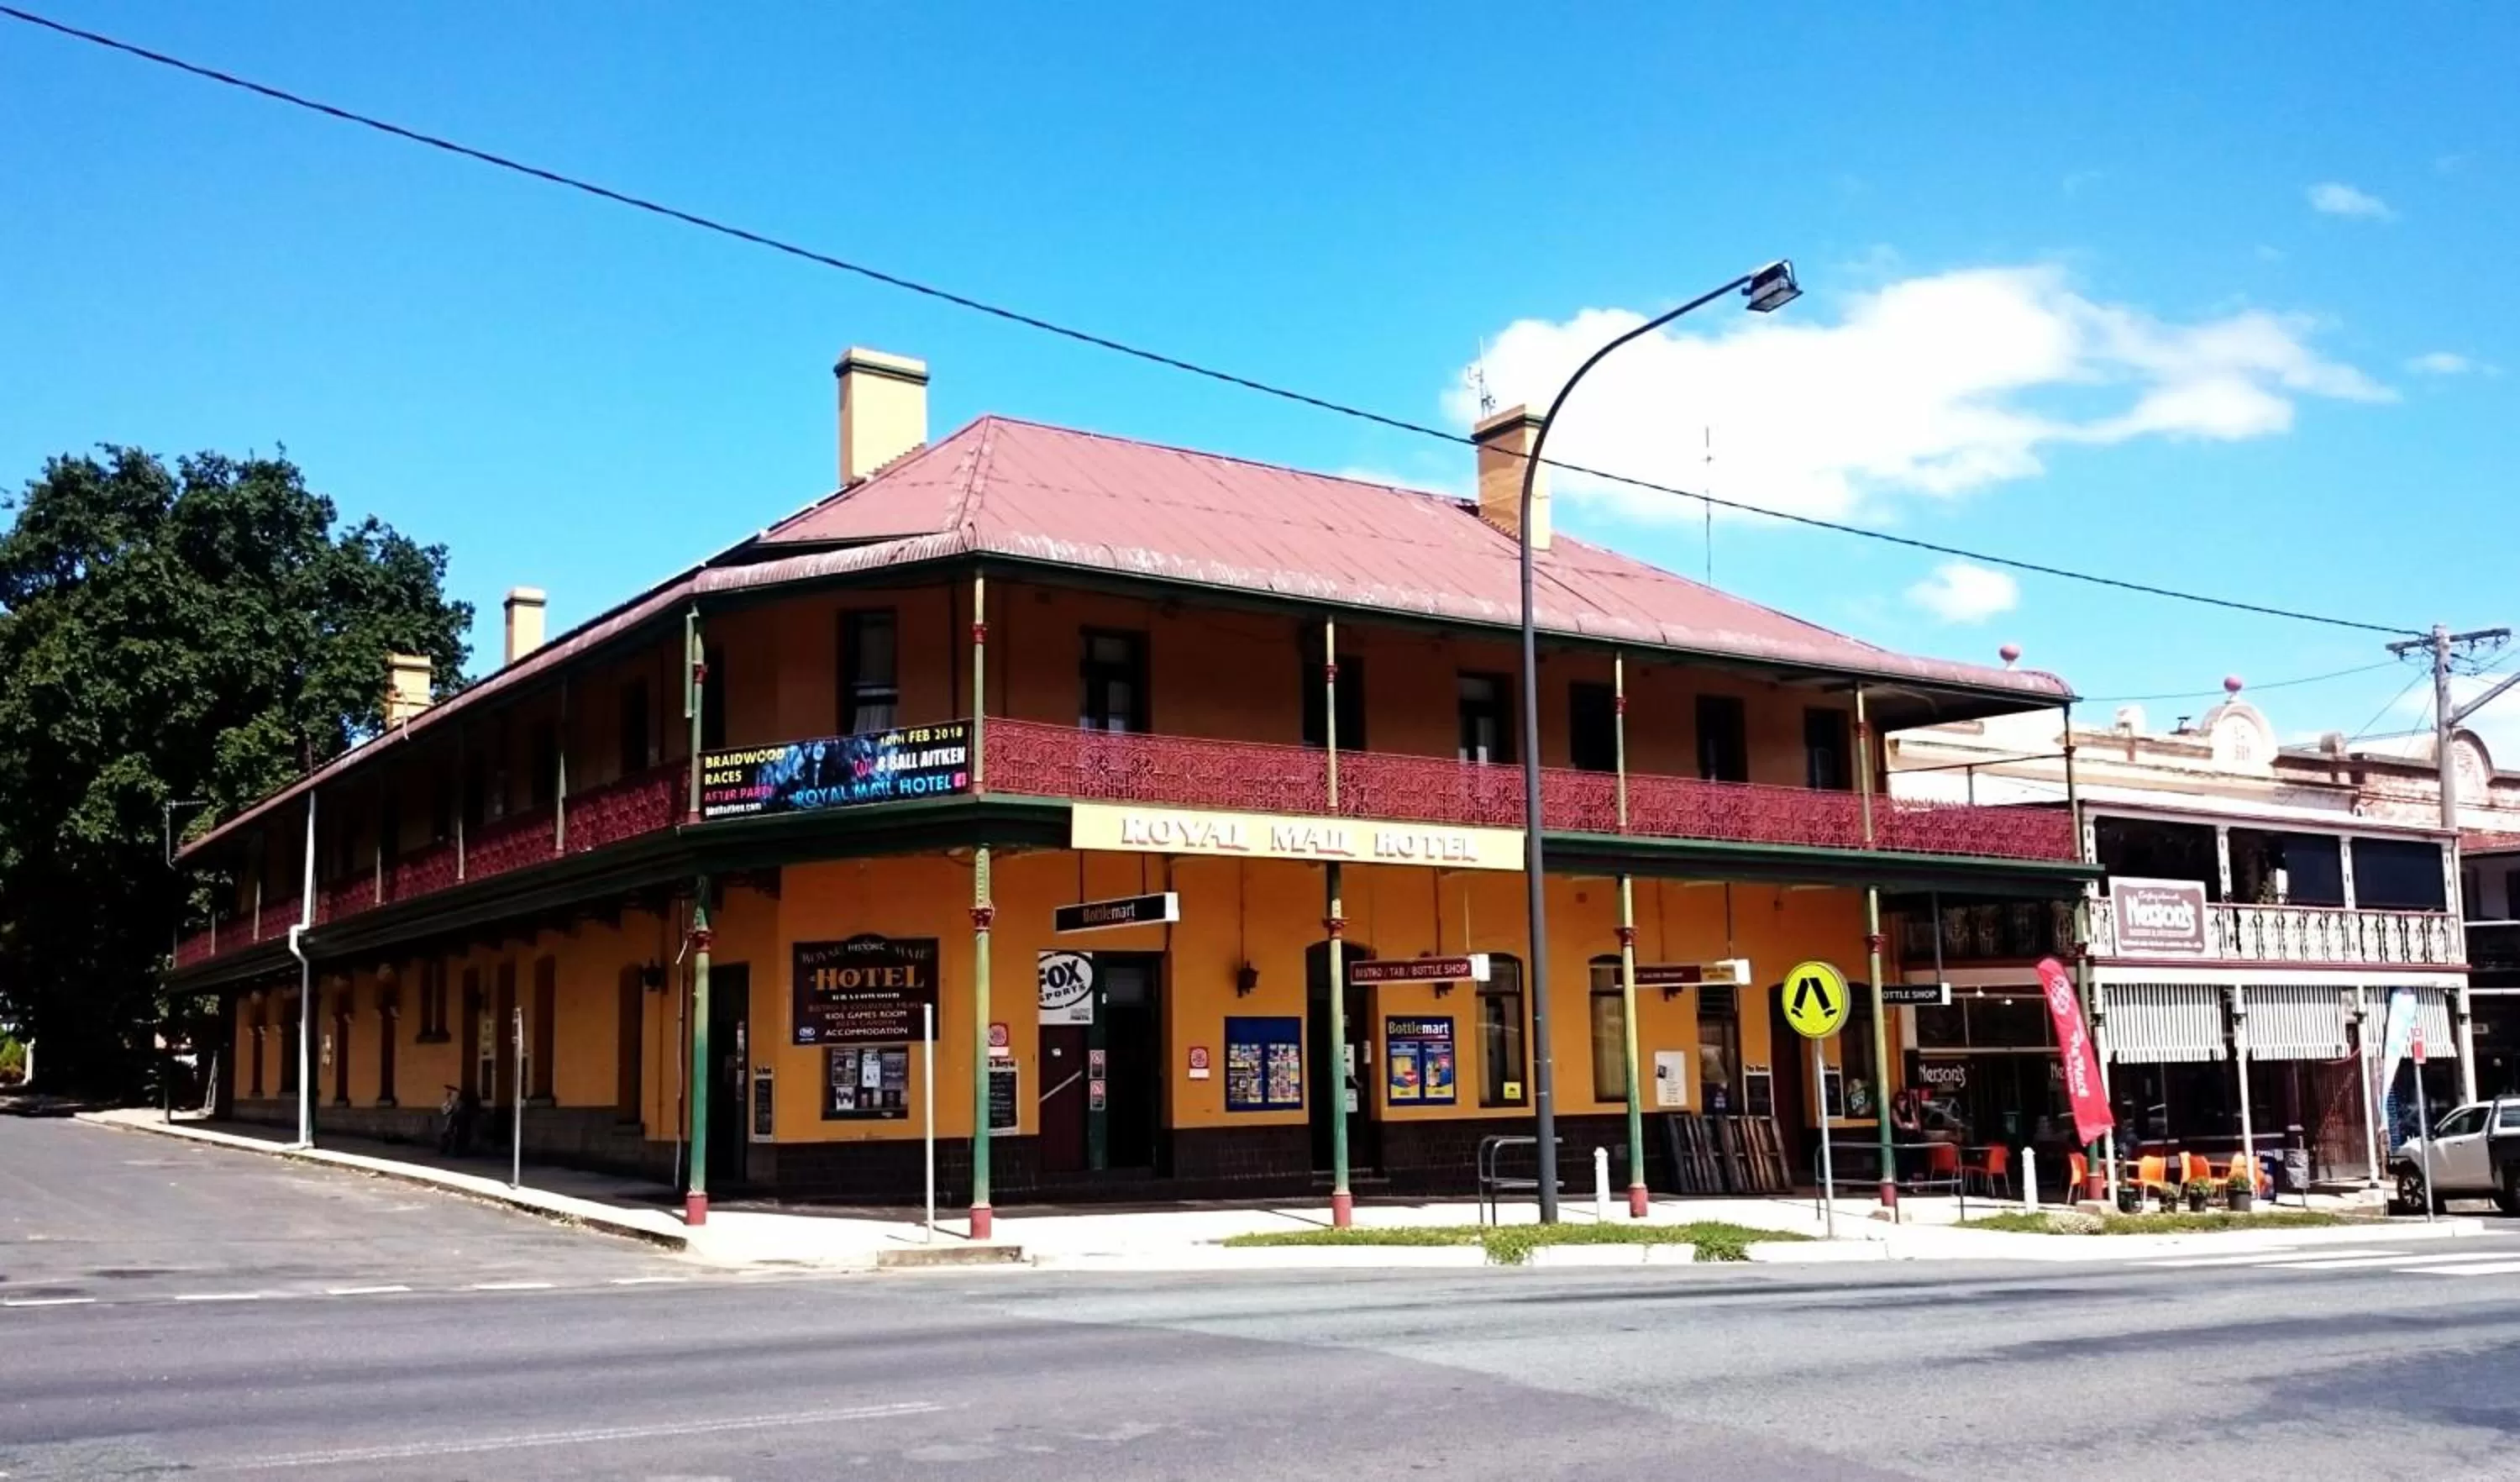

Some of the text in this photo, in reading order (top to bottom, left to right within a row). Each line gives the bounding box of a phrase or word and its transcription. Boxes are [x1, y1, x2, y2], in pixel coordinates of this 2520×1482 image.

[908, 728, 930, 744] FEB
[935, 726, 963, 740] 2018
[705, 747, 785, 769] BRAIDWOOD
[889, 751, 918, 771] BALL
[920, 746, 966, 768] AITKEN
[705, 770, 743, 786] RACES
[705, 785, 774, 802] AFTER PARTY
[795, 784, 848, 806] ROYAL
[899, 774, 952, 795] HOTEL
[1121, 817, 1478, 863] ROYAL MAIL HOTEL
[815, 964, 925, 991] HOTEL
[1038, 959, 1084, 993] FOX
[1355, 967, 1383, 979] BISTRO
[1389, 966, 1405, 977] TAB
[1411, 964, 1442, 975] BOTTLE
[1444, 963, 1467, 975] SHOP
[1038, 983, 1086, 1002] SPORTS
[1882, 990, 1937, 1000] OTTLE SHOP
[847, 1011, 877, 1019] GAMES
[1389, 1021, 1449, 1035] Bottlemart
